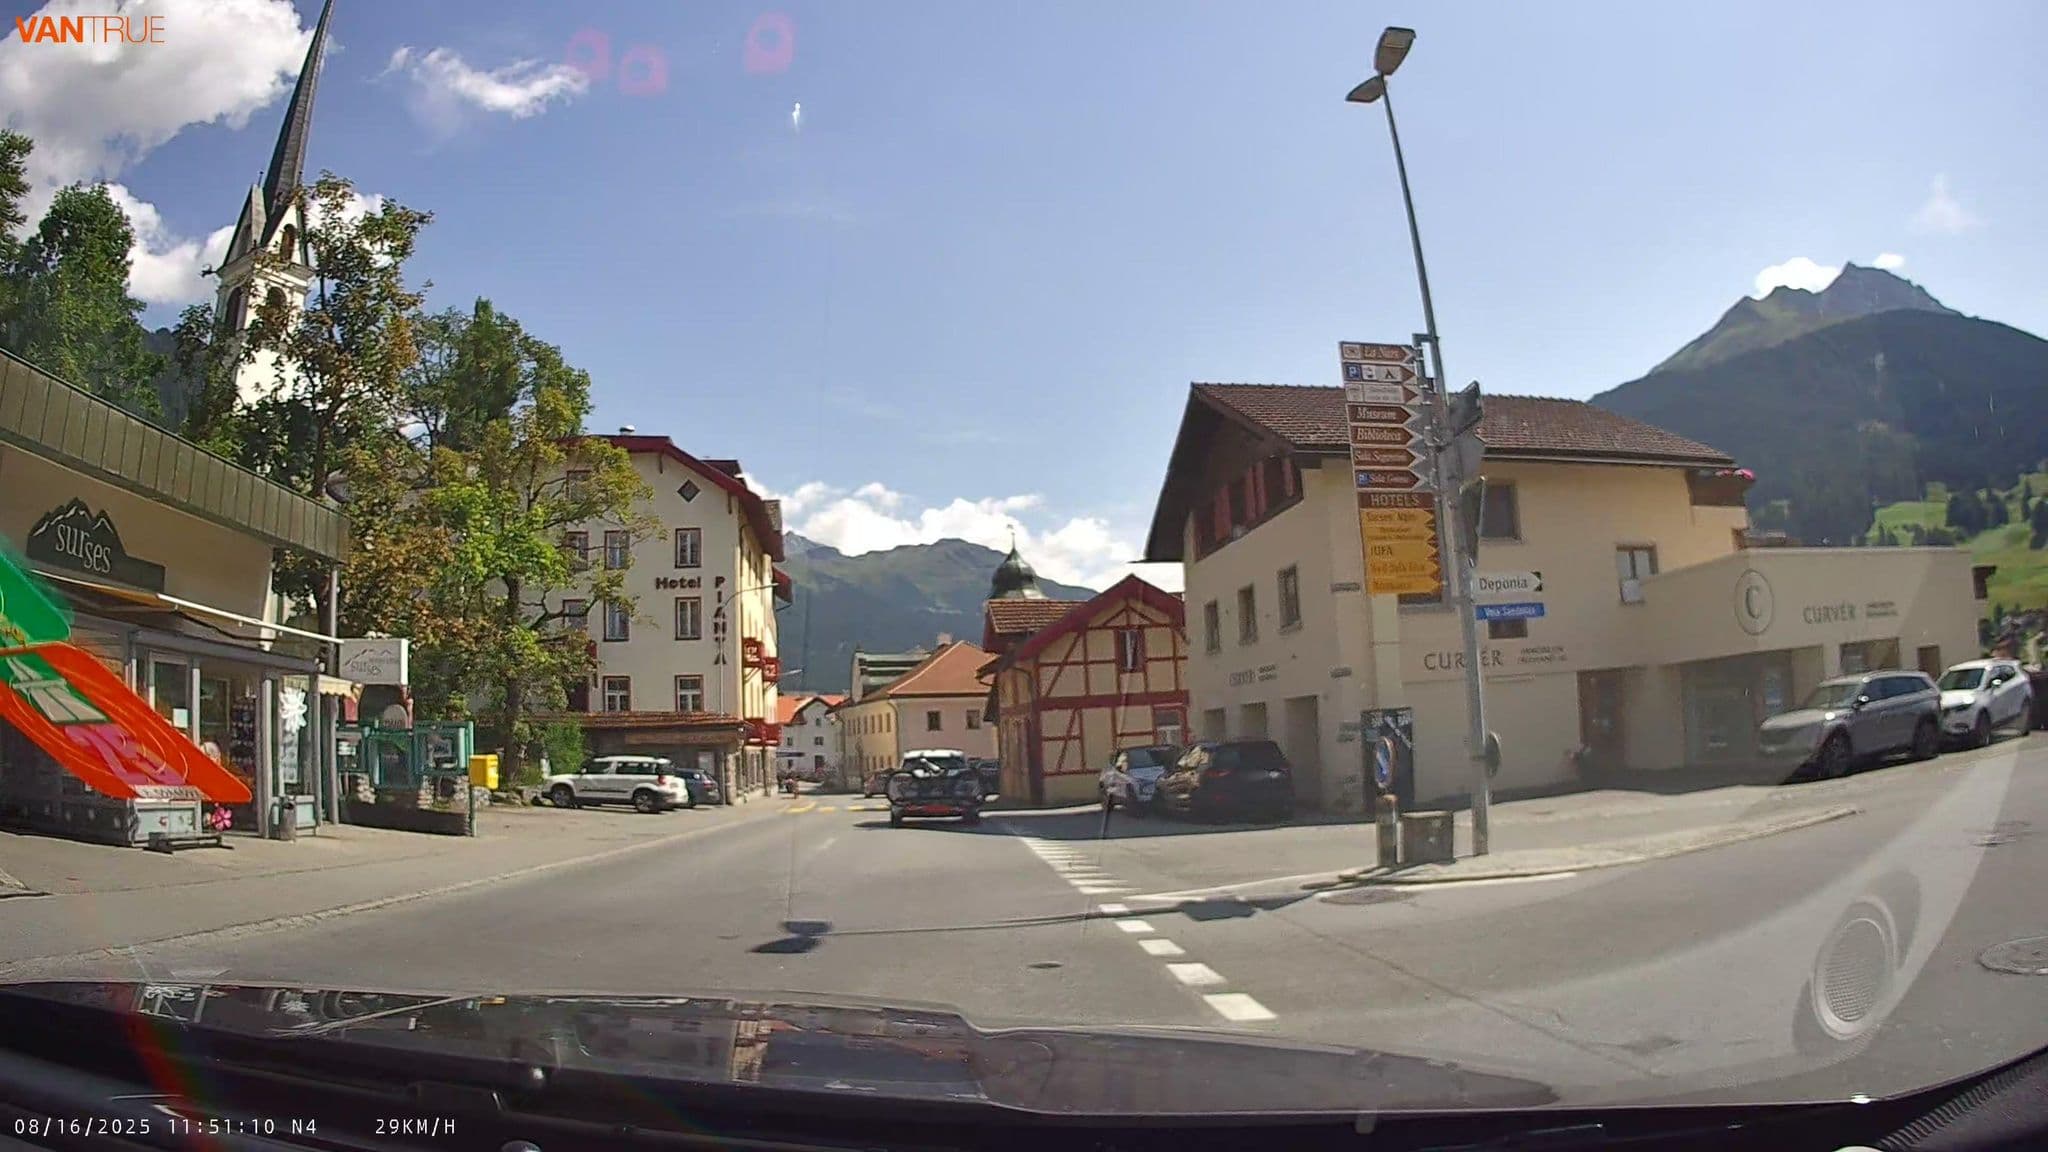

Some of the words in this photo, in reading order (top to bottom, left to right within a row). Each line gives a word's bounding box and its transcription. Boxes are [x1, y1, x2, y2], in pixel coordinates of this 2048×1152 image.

[1370, 494, 1420, 506] HOTELS
[55, 523, 111, 574] surses
[655, 576, 702, 590] Hotel
[1479, 578, 1528, 592] Deponia
[1423, 645, 1504, 671] CURÉR
